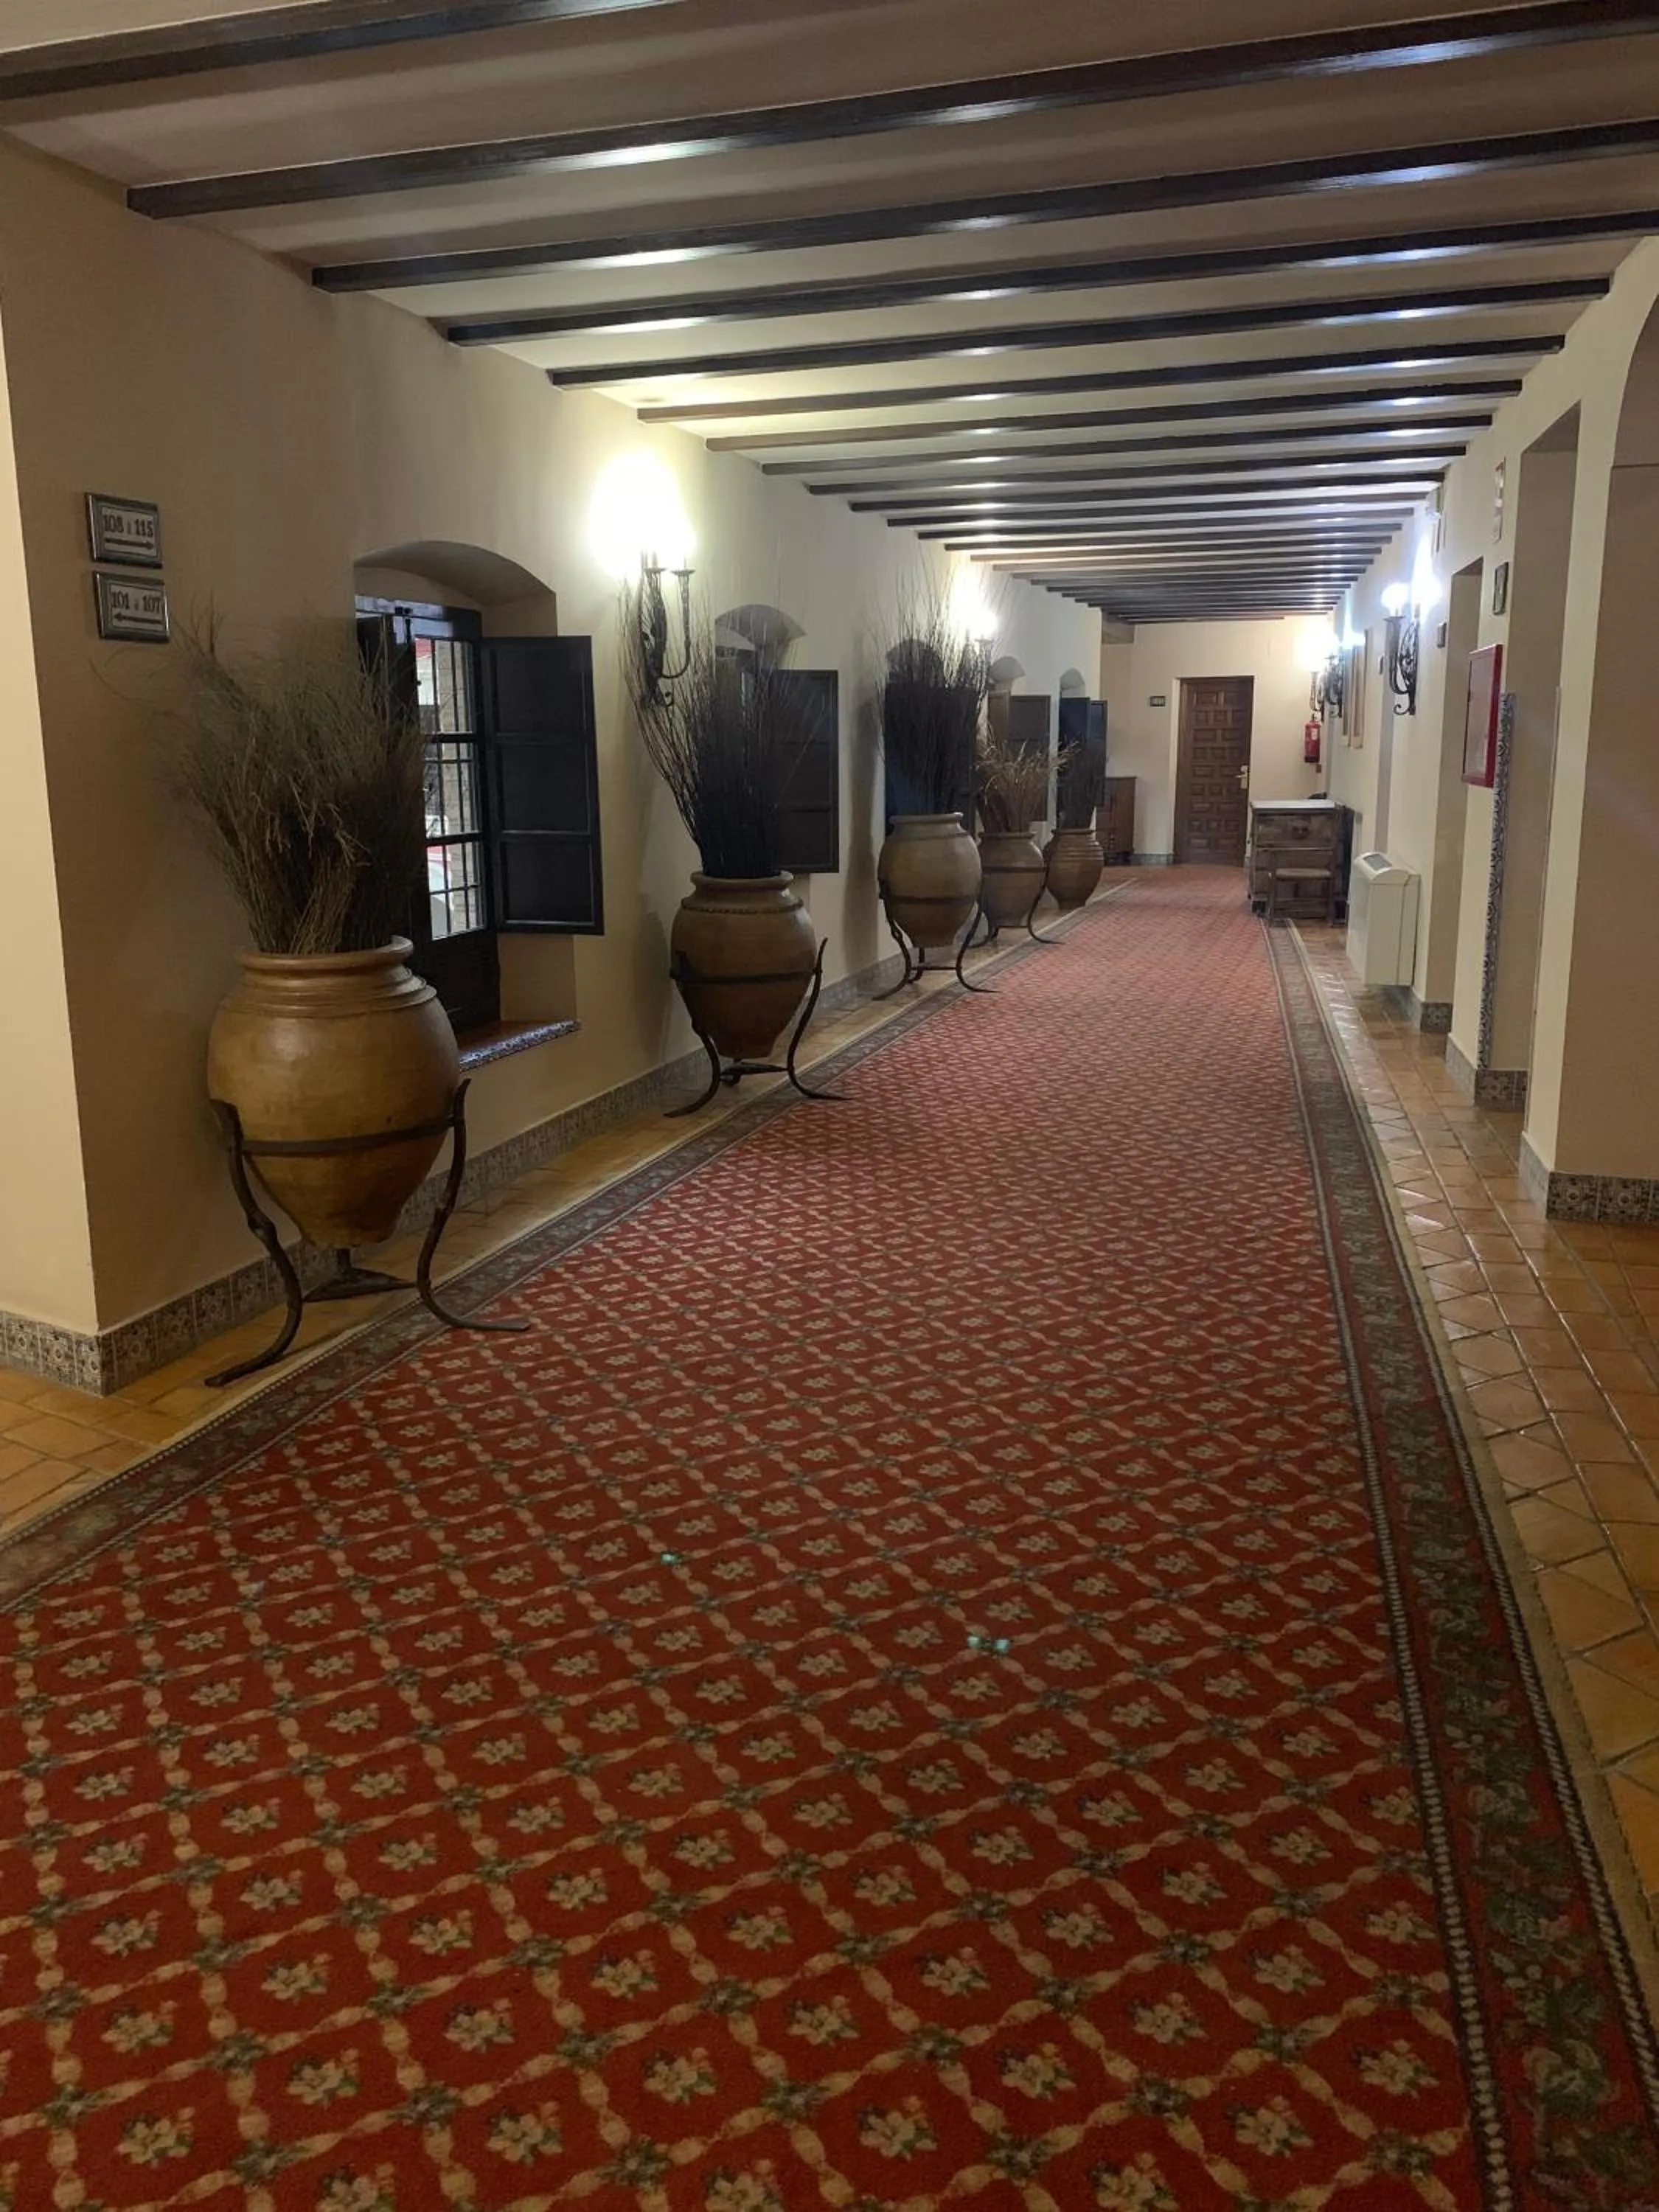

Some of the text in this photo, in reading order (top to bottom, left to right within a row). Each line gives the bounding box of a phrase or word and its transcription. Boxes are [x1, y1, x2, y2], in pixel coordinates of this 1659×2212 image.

[133, 518, 153, 538] 115
[111, 591, 130, 610] 101
[142, 594, 161, 613] 107
